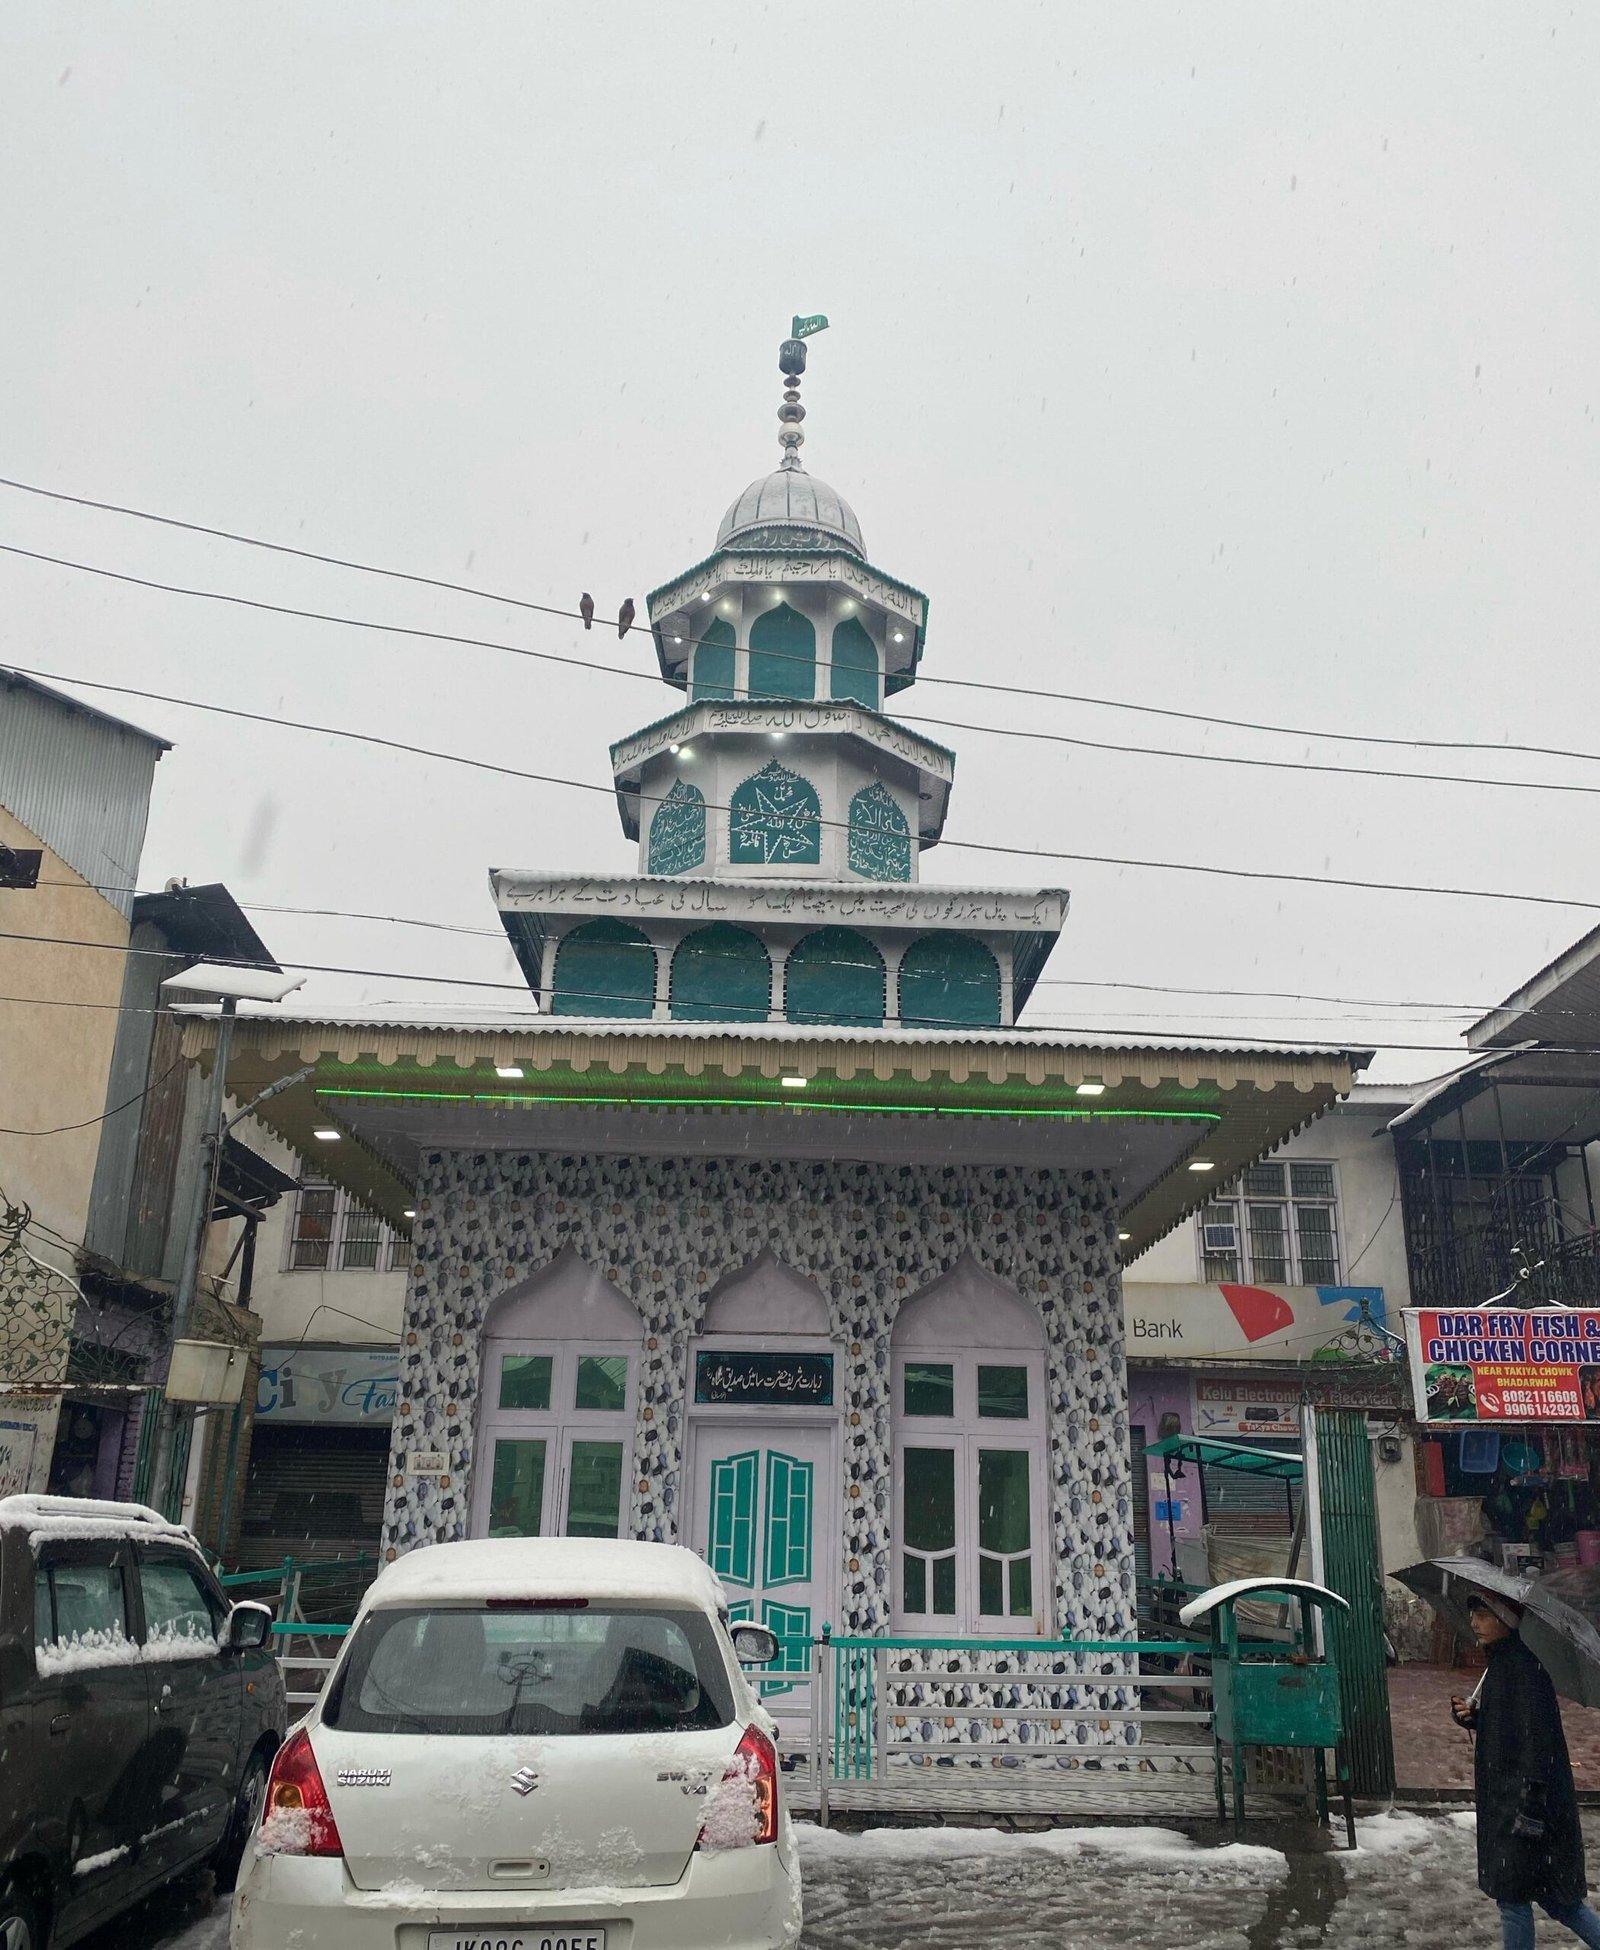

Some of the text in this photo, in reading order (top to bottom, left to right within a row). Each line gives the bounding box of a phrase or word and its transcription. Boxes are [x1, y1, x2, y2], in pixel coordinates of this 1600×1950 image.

[1133, 1318, 1183, 1338] Bank
[1438, 1314, 1484, 1337] DAR
[1487, 1314, 1528, 1338] FRY
[1531, 1314, 1580, 1338] FISH
[1428, 1339, 1527, 1363] CHICKEN
[1477, 1366, 1574, 1377] NEAR TAKIYA CHOWK
[1497, 1378, 1558, 1387] BHADARWAH
[1502, 1390, 1578, 1403] 8082116608
[1504, 1403, 1580, 1416] 9906142920
[338, 1769, 392, 1777] MARUTI
[337, 1776, 392, 1787] SUZUKI
